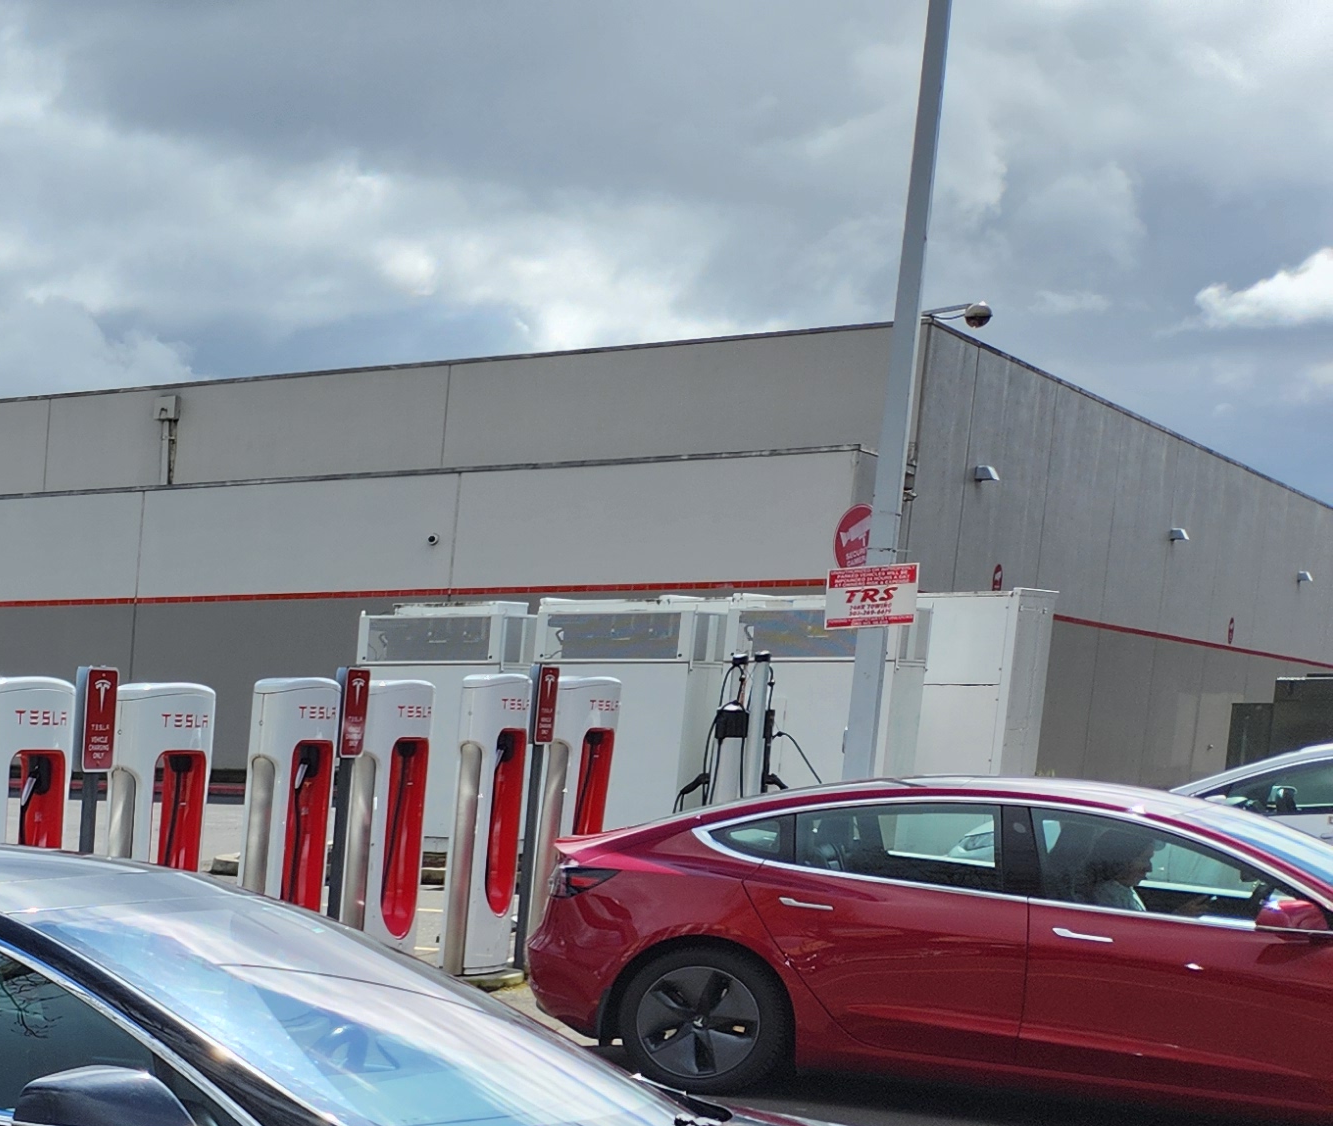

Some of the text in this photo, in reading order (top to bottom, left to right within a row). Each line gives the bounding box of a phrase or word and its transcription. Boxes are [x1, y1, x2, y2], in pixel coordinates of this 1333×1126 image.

[845, 587, 898, 603] TRS
[15, 710, 67, 726] TESLA
[162, 714, 208, 728] TESLA
